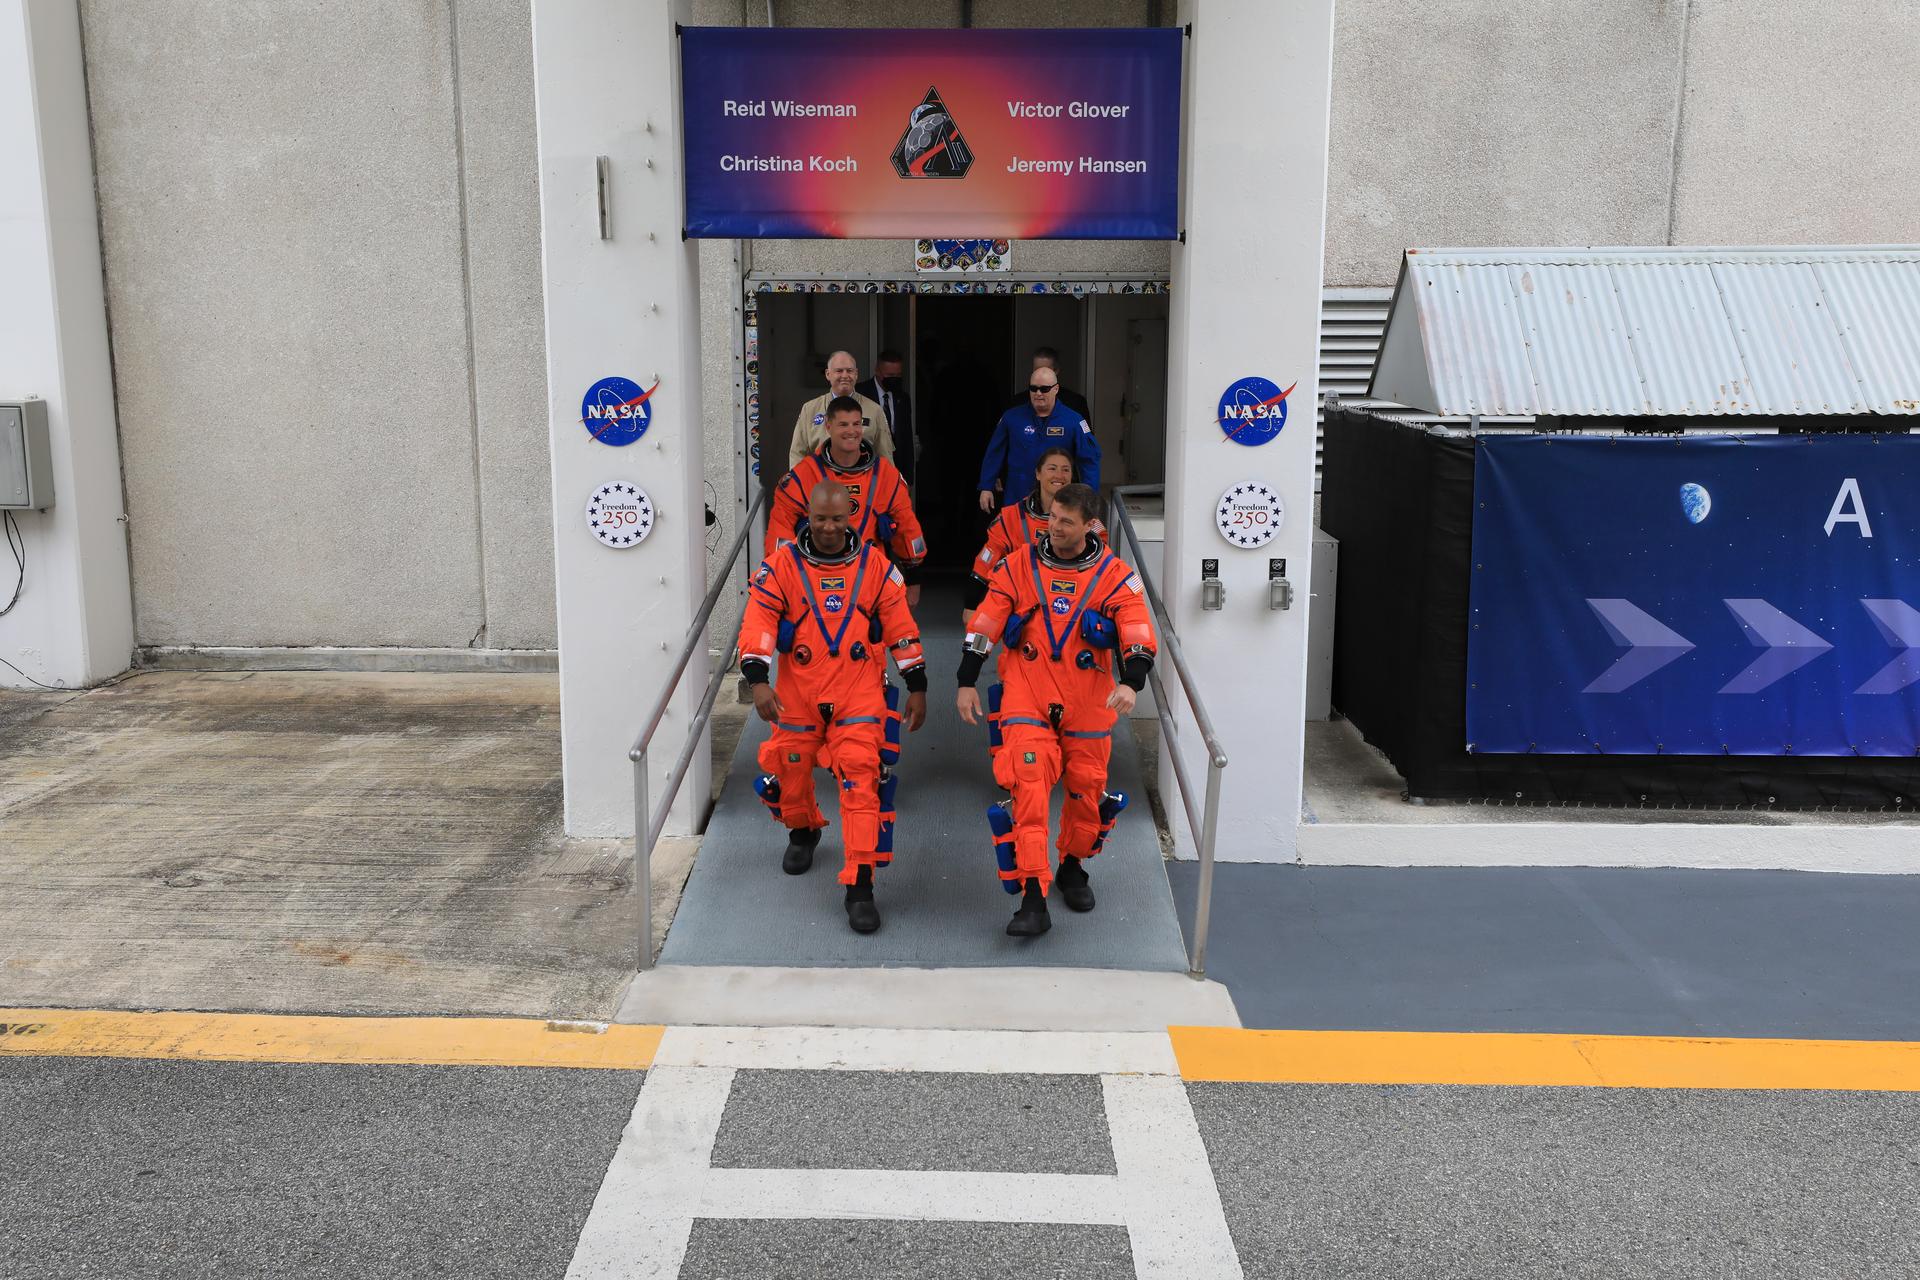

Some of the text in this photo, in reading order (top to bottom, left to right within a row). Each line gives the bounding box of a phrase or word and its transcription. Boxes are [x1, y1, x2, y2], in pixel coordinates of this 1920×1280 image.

[723, 100, 858, 117] Reid Wiseman
[1006, 101, 1130, 118] Victor Glover
[719, 155, 858, 173] Christina Koch
[1006, 157, 1148, 177] Jeremy Hansen
[587, 404, 648, 419] NASA
[1223, 404, 1284, 419] NASA
[601, 503, 638, 511] Freedom
[1232, 503, 1269, 511] Freedom
[1823, 477, 1873, 538] A
[602, 511, 638, 529] 250
[1232, 511, 1269, 529] 250
